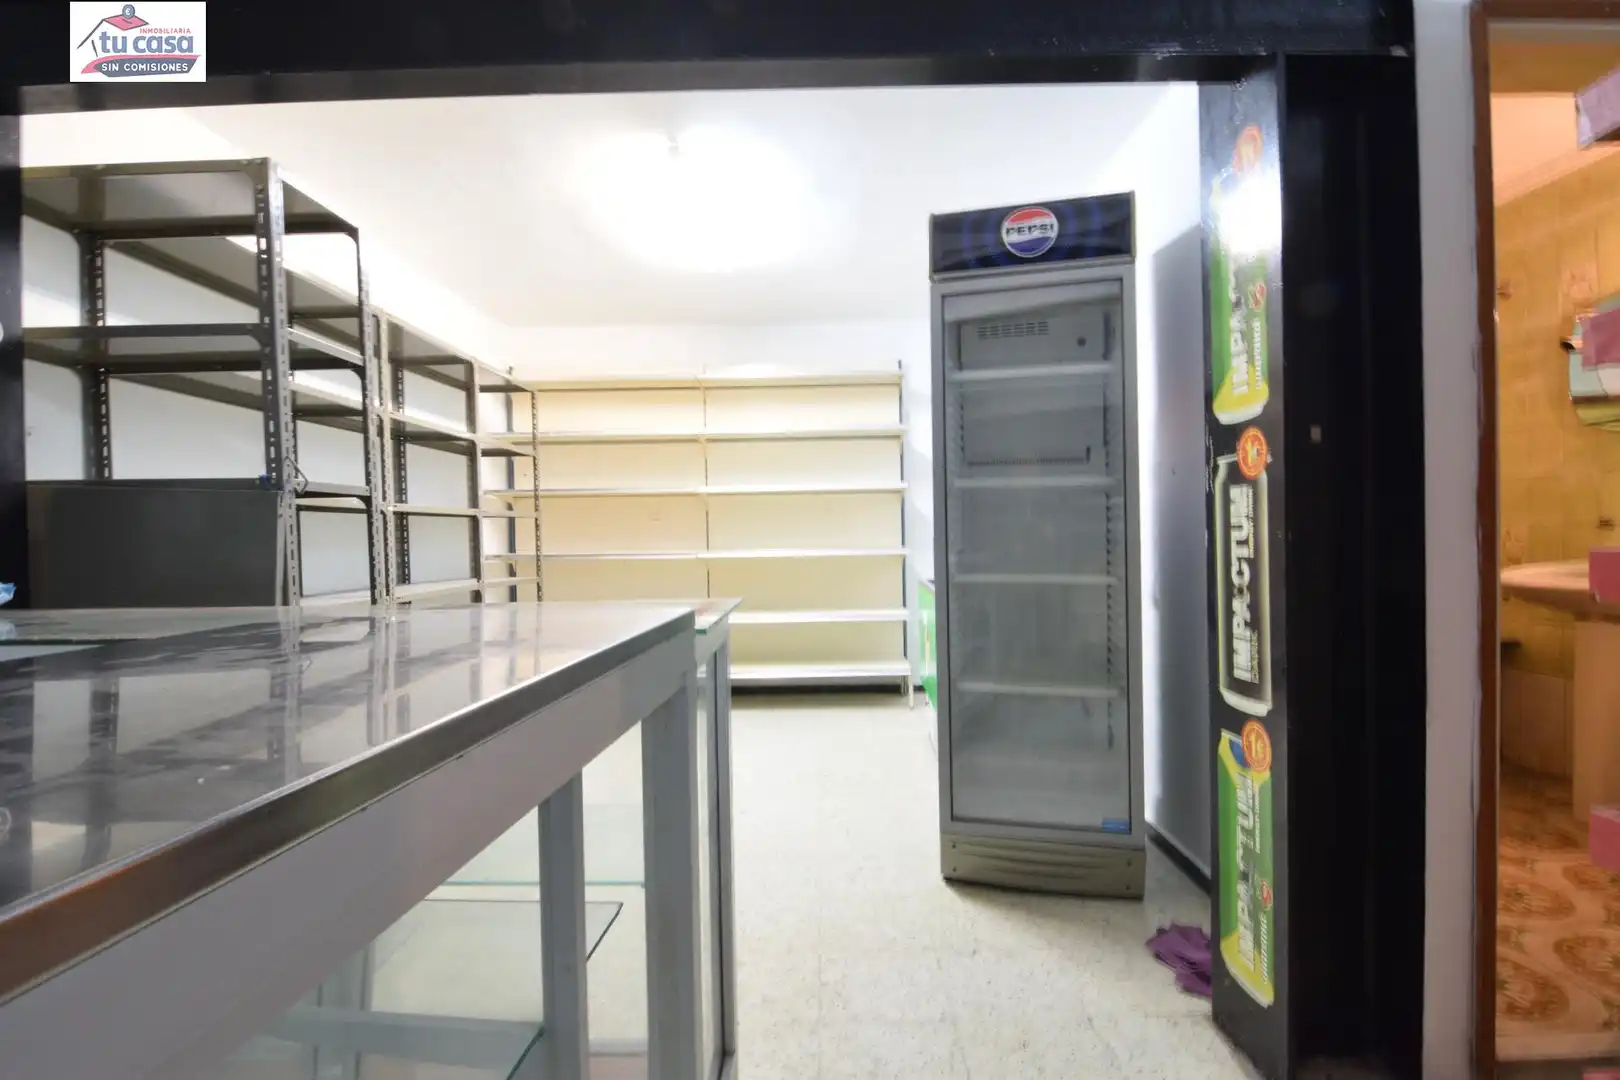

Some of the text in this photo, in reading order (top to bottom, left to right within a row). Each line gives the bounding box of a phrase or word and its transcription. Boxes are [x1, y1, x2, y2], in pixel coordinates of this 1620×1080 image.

[1006, 223, 1054, 236] PEPSI
[1230, 484, 1251, 682] IMPACTUM
[1236, 772, 1255, 973] IMPACTUM
